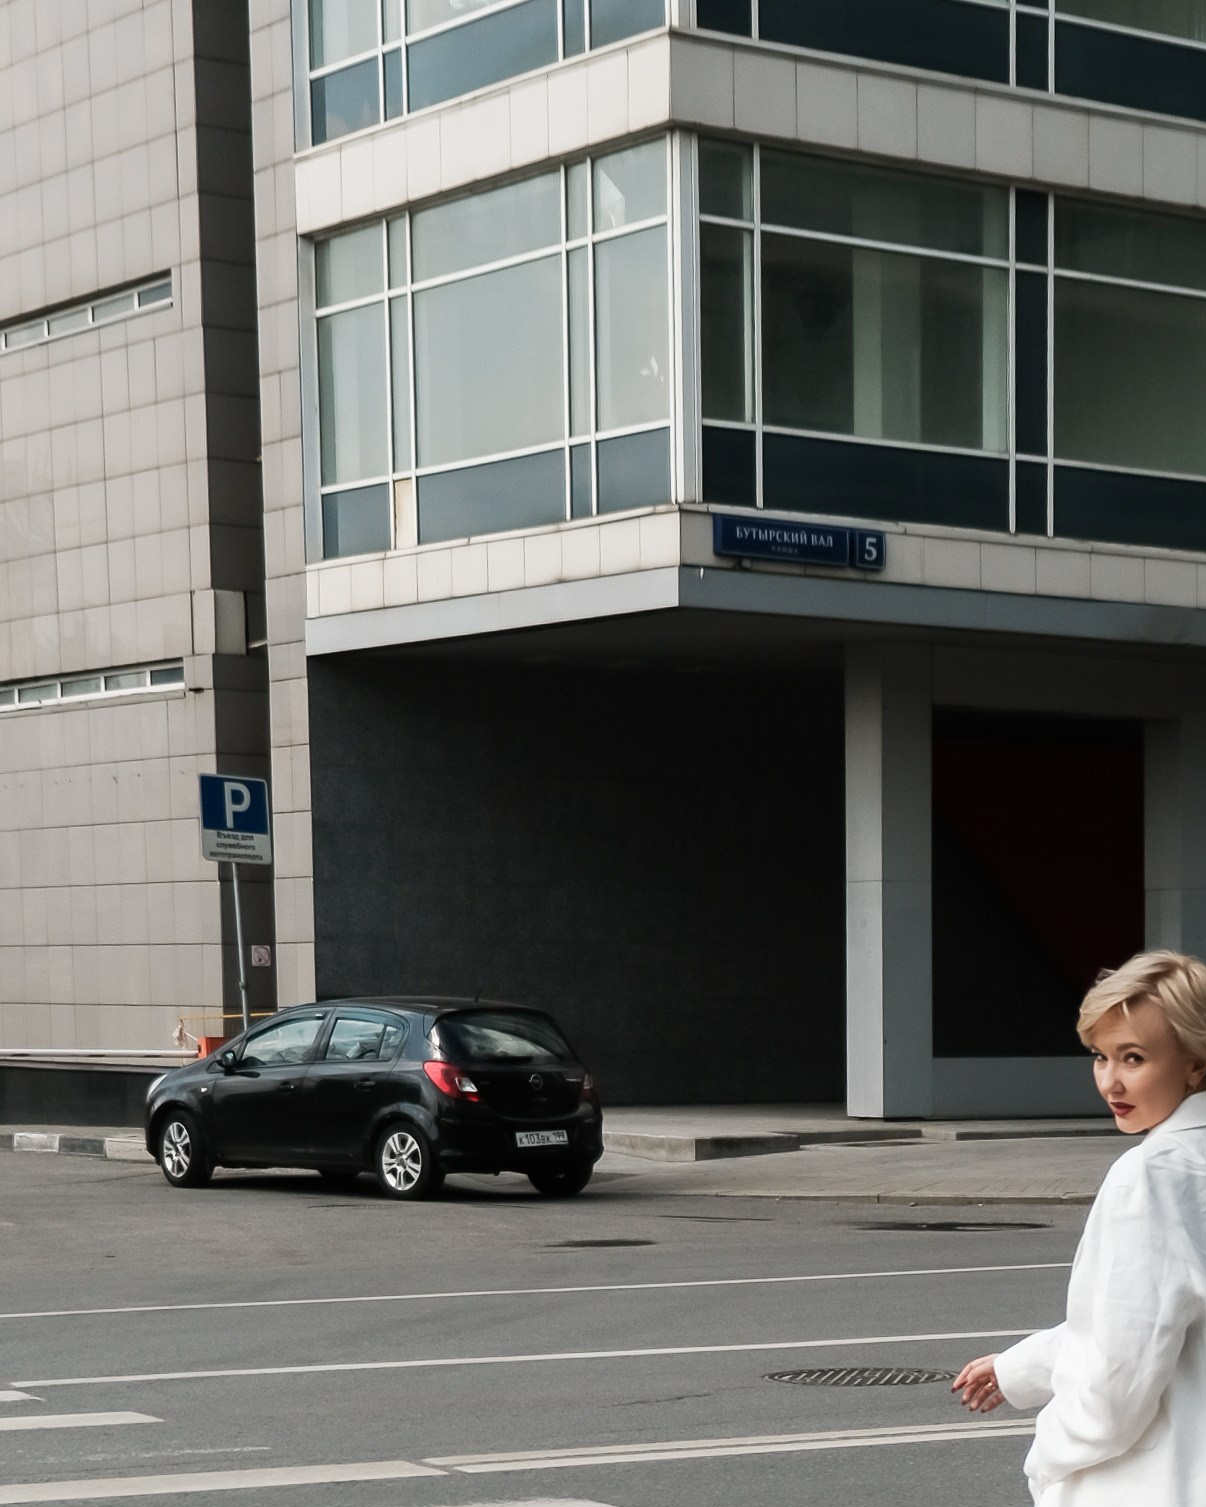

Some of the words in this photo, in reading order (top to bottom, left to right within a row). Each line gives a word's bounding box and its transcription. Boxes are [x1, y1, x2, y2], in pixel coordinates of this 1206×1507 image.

[736, 526, 807, 545] БУТЫРСКИЙ
[811, 533, 833, 548] ВАЛ
[864, 537, 878, 562] 5
